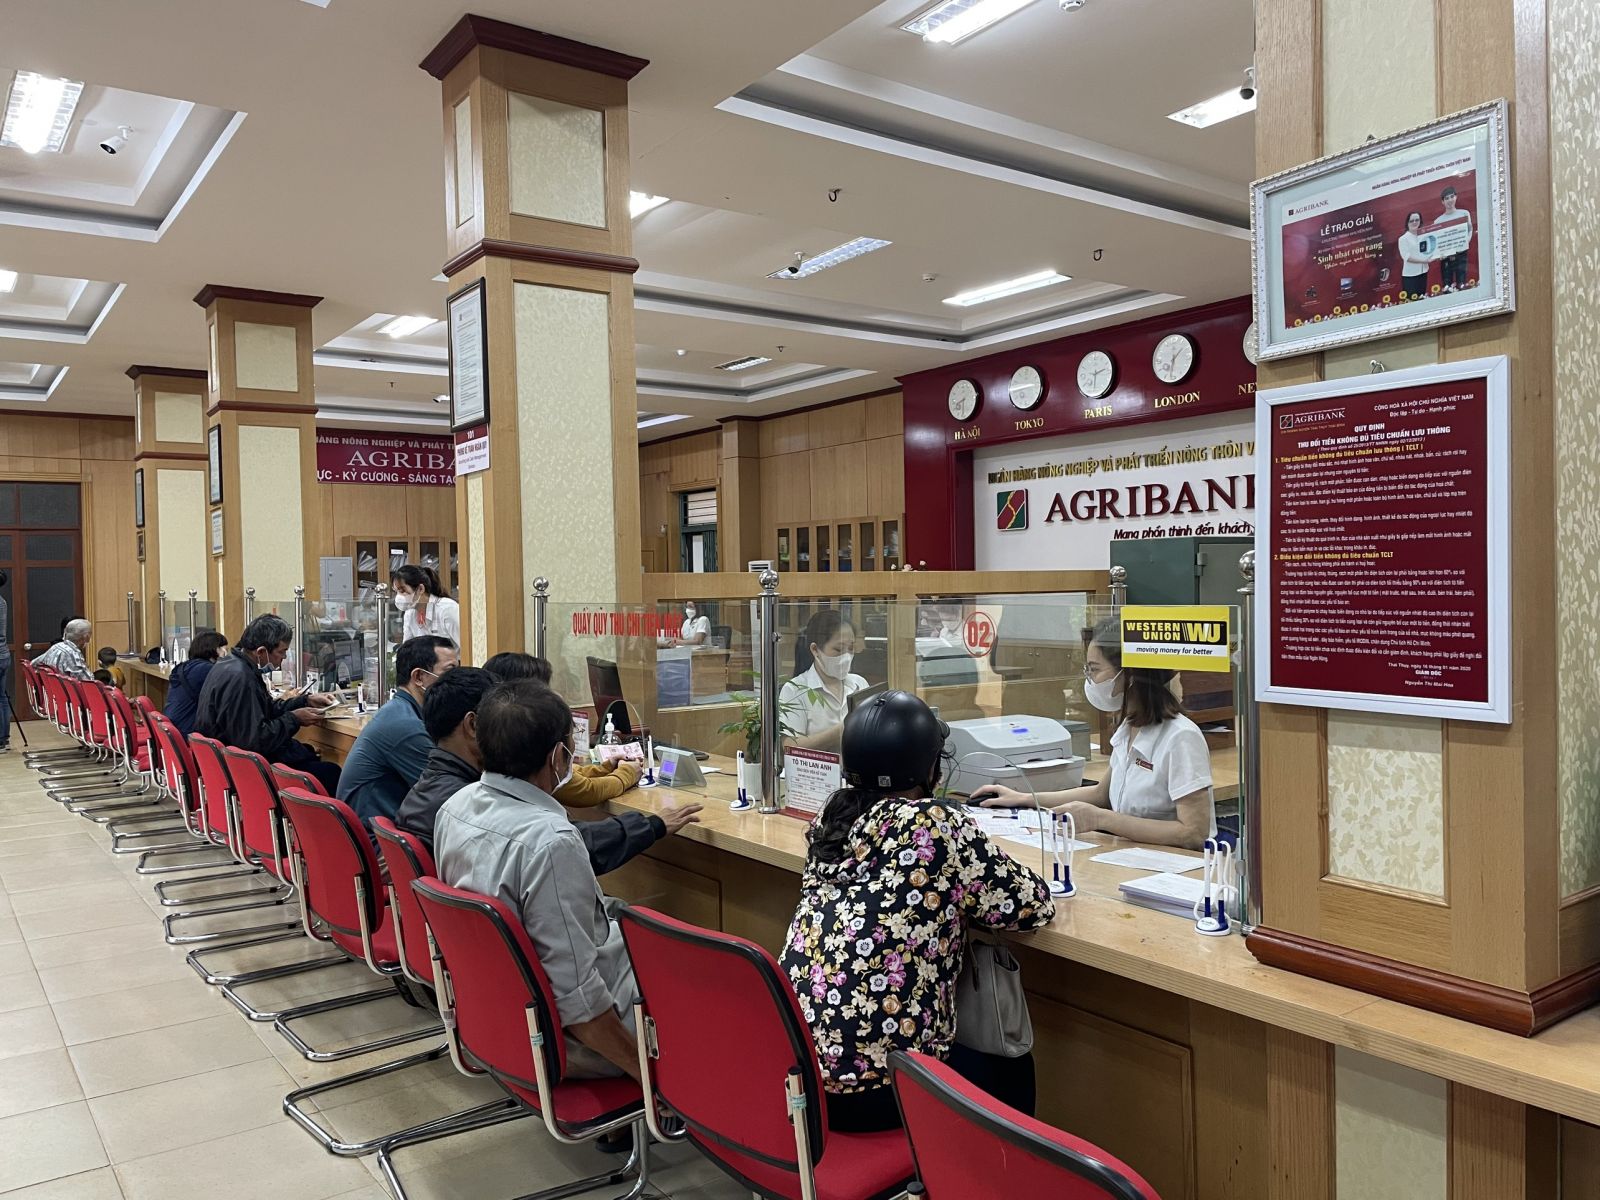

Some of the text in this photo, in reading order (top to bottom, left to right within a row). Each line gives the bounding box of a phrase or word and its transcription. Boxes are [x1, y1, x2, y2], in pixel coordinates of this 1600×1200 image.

[1295, 200, 1328, 214] AGRIBANK
[1321, 225, 1330, 236] LỄ
[1331, 220, 1354, 233] TRAO
[1356, 214, 1374, 226] GIẢI
[1238, 382, 1256, 395] NE
[1154, 391, 1200, 408] LONDON
[1084, 405, 1112, 419] PARIS
[1295, 411, 1345, 424] AGRIBANK
[1015, 418, 1043, 431] TOKYO
[1369, 422, 1385, 432] ĐỊNH
[954, 426, 980, 440] HÀ NỘI
[1337, 435, 1358, 444] KHÔNG
[1412, 428, 1425, 436] LƯU
[1427, 426, 1450, 434] THÔNG
[342, 437, 368, 446] NÔNG
[372, 439, 405, 448] NGHIỆP
[408, 440, 420, 448] VÀ
[422, 440, 444, 449] PHÁT
[988, 440, 1255, 484] NGÂN HÀNG NÔNG NGHIỆP VÀ PHÁT TRIỂN NÔNG THÔN V
[317, 469, 332, 480] ỰC
[343, 468, 357, 480] KỶ
[361, 471, 399, 482] CƯƠNG
[408, 471, 436, 483] SÁNG
[1195, 522, 1214, 535] đến
[1218, 522, 1250, 535] khách
[610, 612, 624, 636] THU
[627, 612, 640, 636] CHI
[1126, 622, 1180, 631] WESTERN
[968, 621, 990, 647] 02
[1143, 632, 1180, 640] UNION
[1187, 623, 1220, 643] WU
